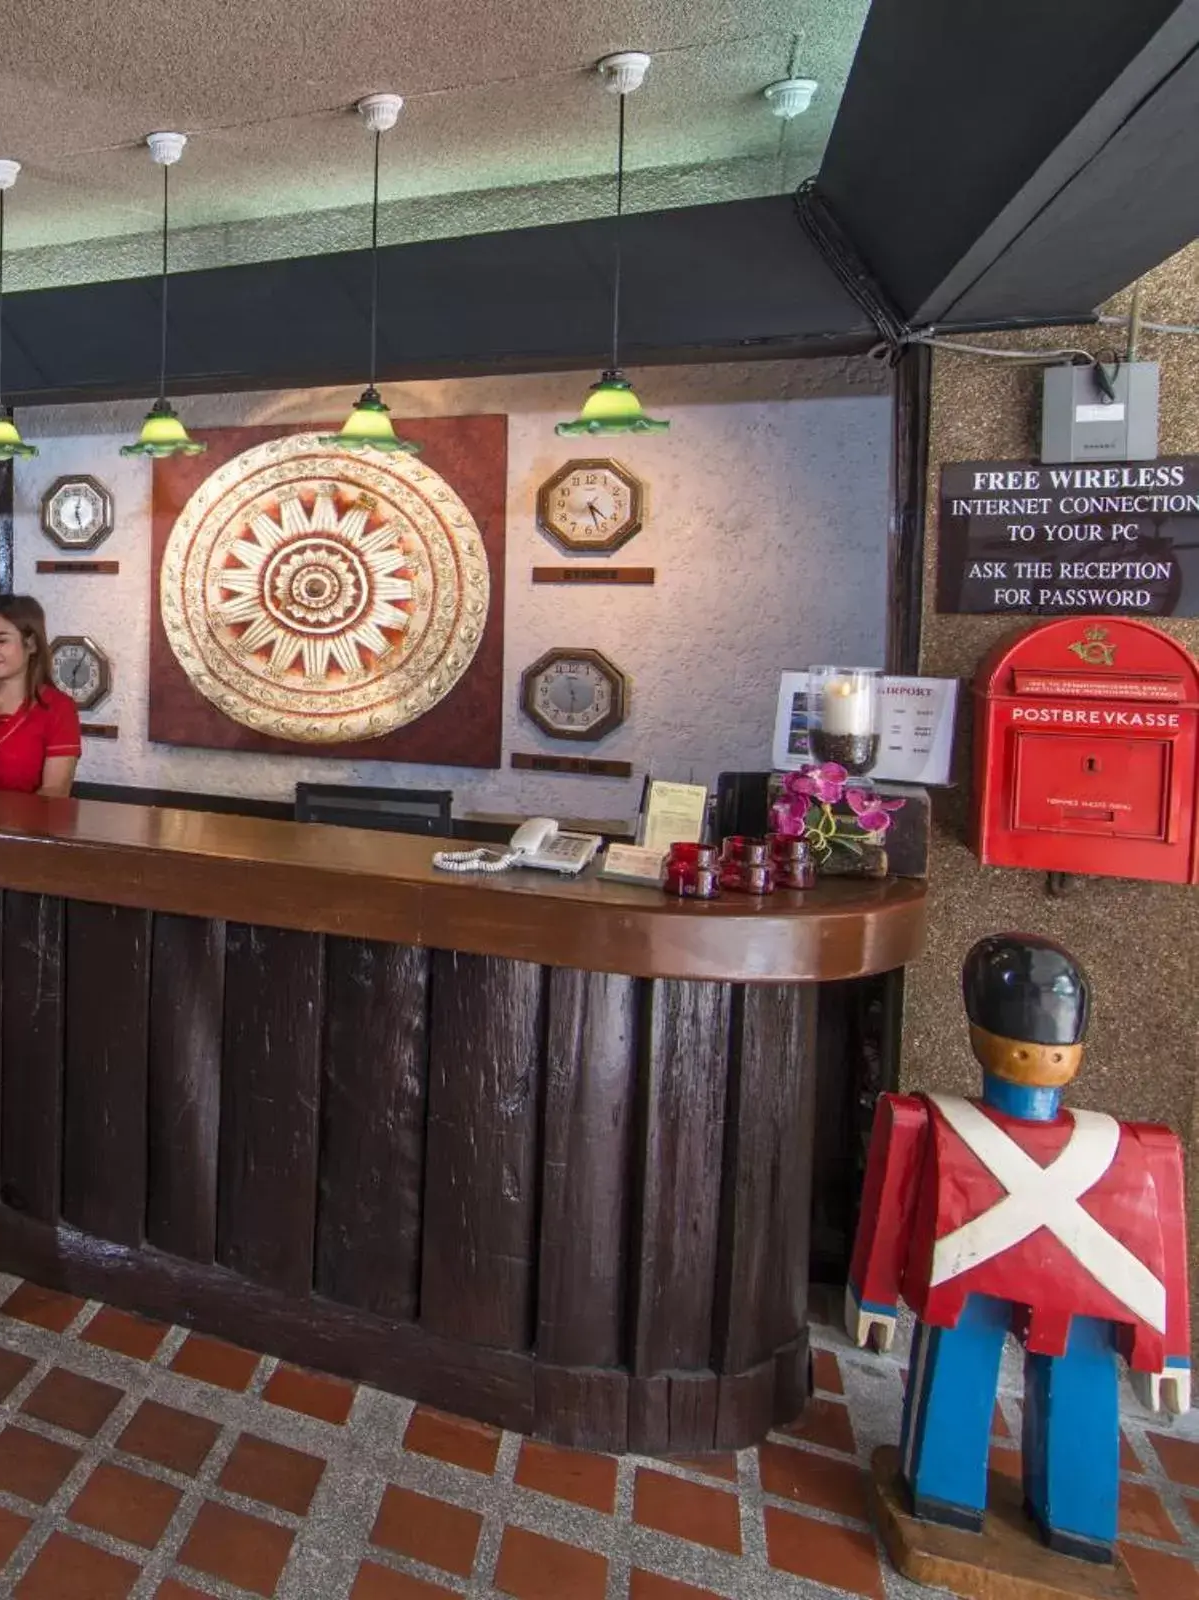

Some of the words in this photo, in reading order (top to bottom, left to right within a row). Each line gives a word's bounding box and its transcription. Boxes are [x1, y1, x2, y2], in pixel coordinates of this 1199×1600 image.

[585, 474, 598, 485] 12
[973, 471, 1040, 491] FREE
[1050, 466, 1185, 489] WIRELESS
[951, 498, 1052, 516] INTERNET
[1007, 525, 1035, 541] TO
[1044, 524, 1103, 541] YOUR
[1111, 523, 1139, 541] PC
[968, 561, 1007, 579] ASK
[1014, 561, 1052, 579] THE
[1060, 561, 1171, 580] RECEPTION
[994, 588, 1031, 605] FOR
[1039, 588, 1151, 607] PASSWORD
[876, 687, 933, 697] IRPORT
[1012, 708, 1180, 728] POSTBREVKASSE
